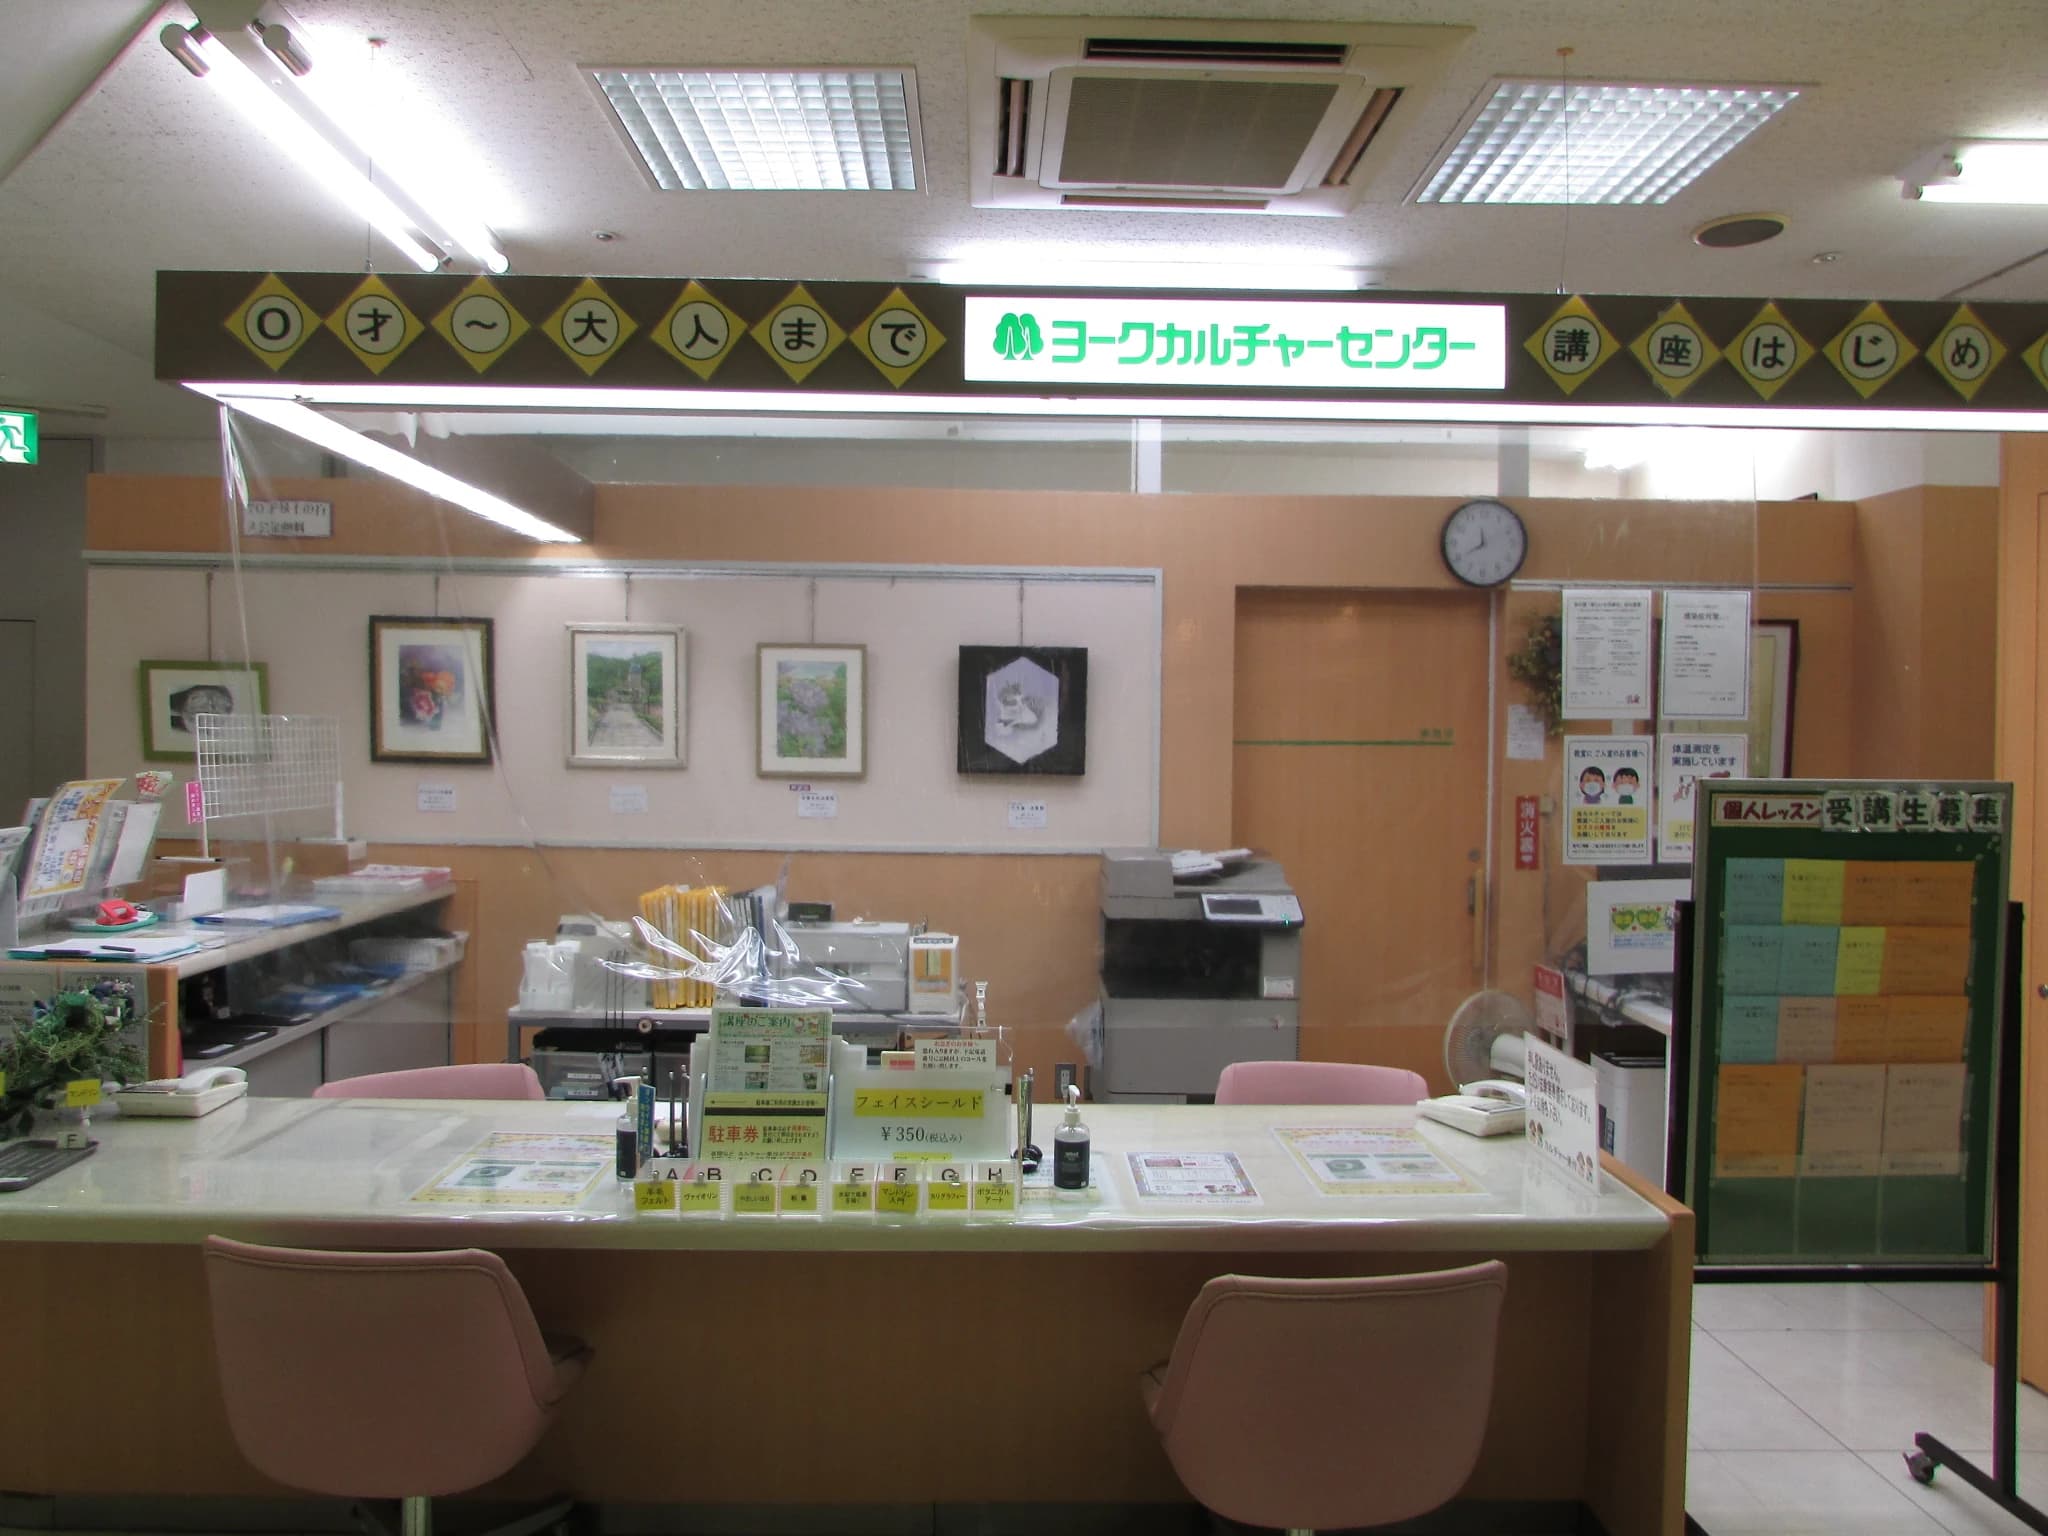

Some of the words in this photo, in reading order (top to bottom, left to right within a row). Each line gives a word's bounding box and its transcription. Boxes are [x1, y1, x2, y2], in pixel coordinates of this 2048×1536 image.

[1052, 320, 1475, 371] ヨークカルチャーセンター
[1722, 801, 1821, 821] 個人レッスン
[1825, 797, 2000, 826] 受講生募集
[856, 1095, 982, 1111] フェイスシールド
[708, 1123, 759, 1144] 駐車券
[666, 1167, 679, 1181] A
[707, 1167, 722, 1181] B
[758, 1167, 773, 1181] C
